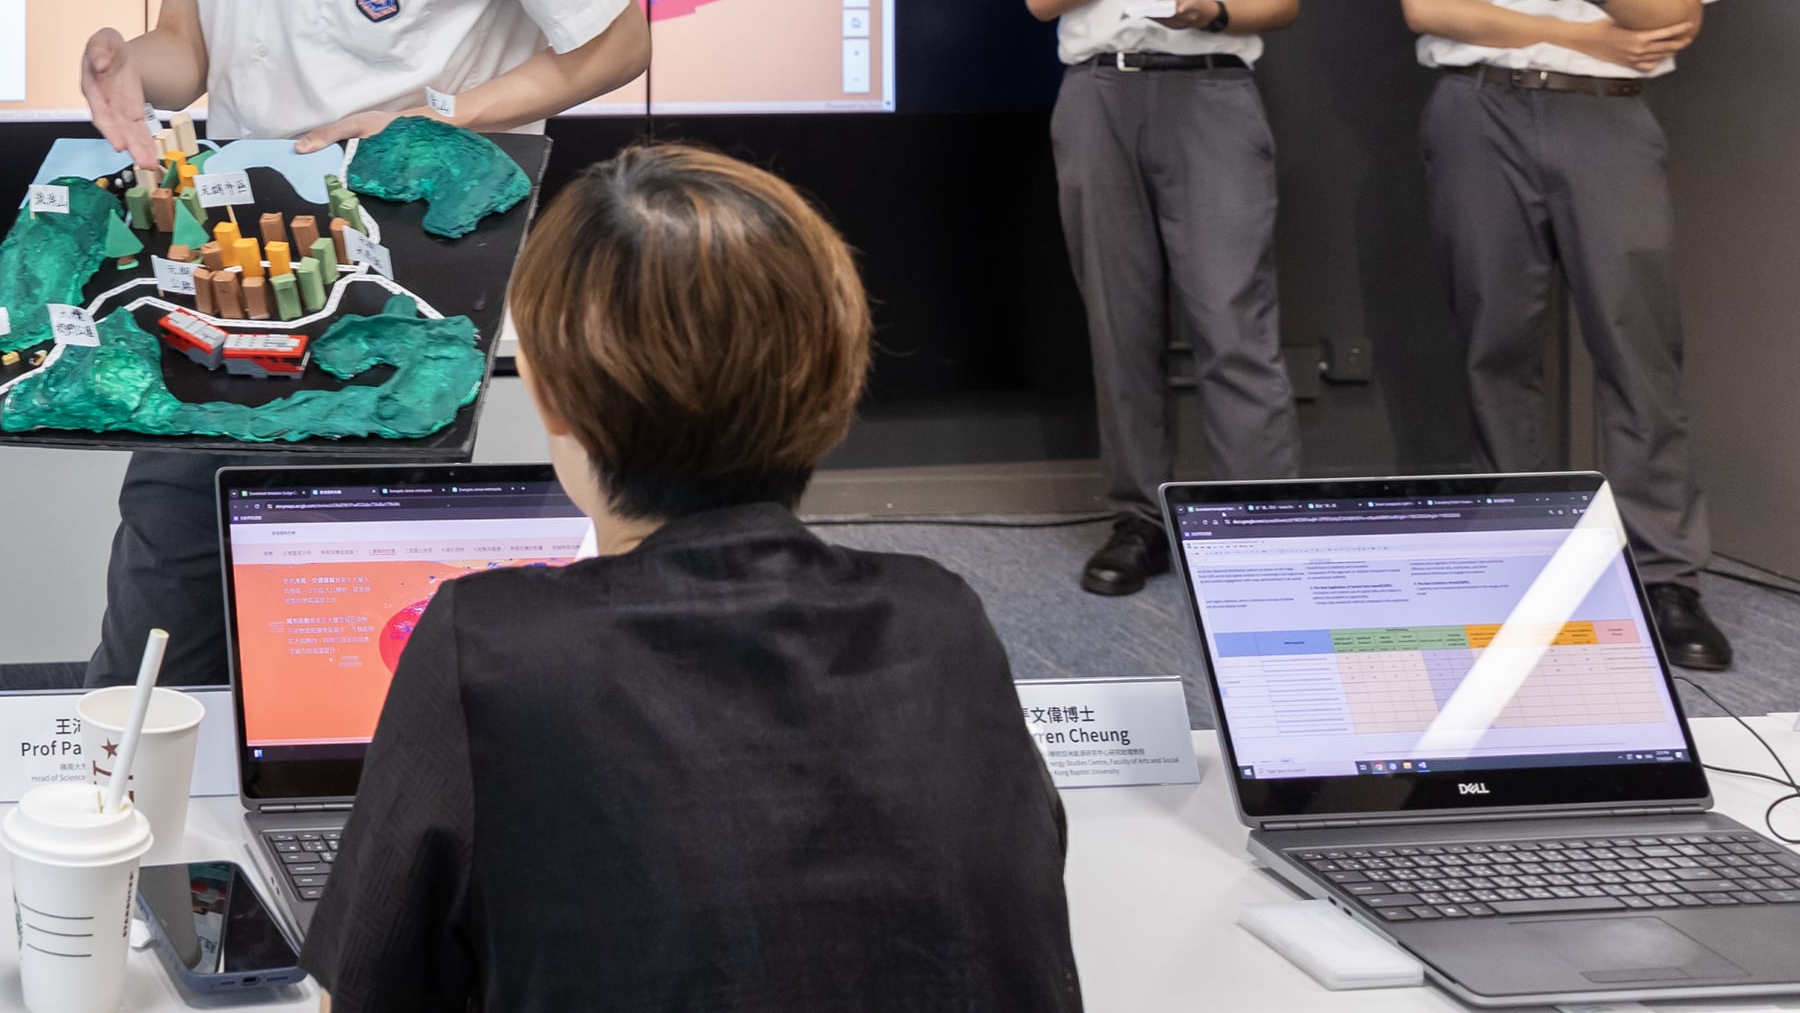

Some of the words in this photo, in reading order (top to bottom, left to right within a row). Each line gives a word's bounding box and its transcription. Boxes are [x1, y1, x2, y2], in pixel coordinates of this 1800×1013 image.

[1069, 728, 1131, 745] Cheung
[21, 740, 57, 756] Prof
[31, 774, 49, 782] Head
[51, 774, 59, 782] of
[1458, 782, 1490, 794] DELL
